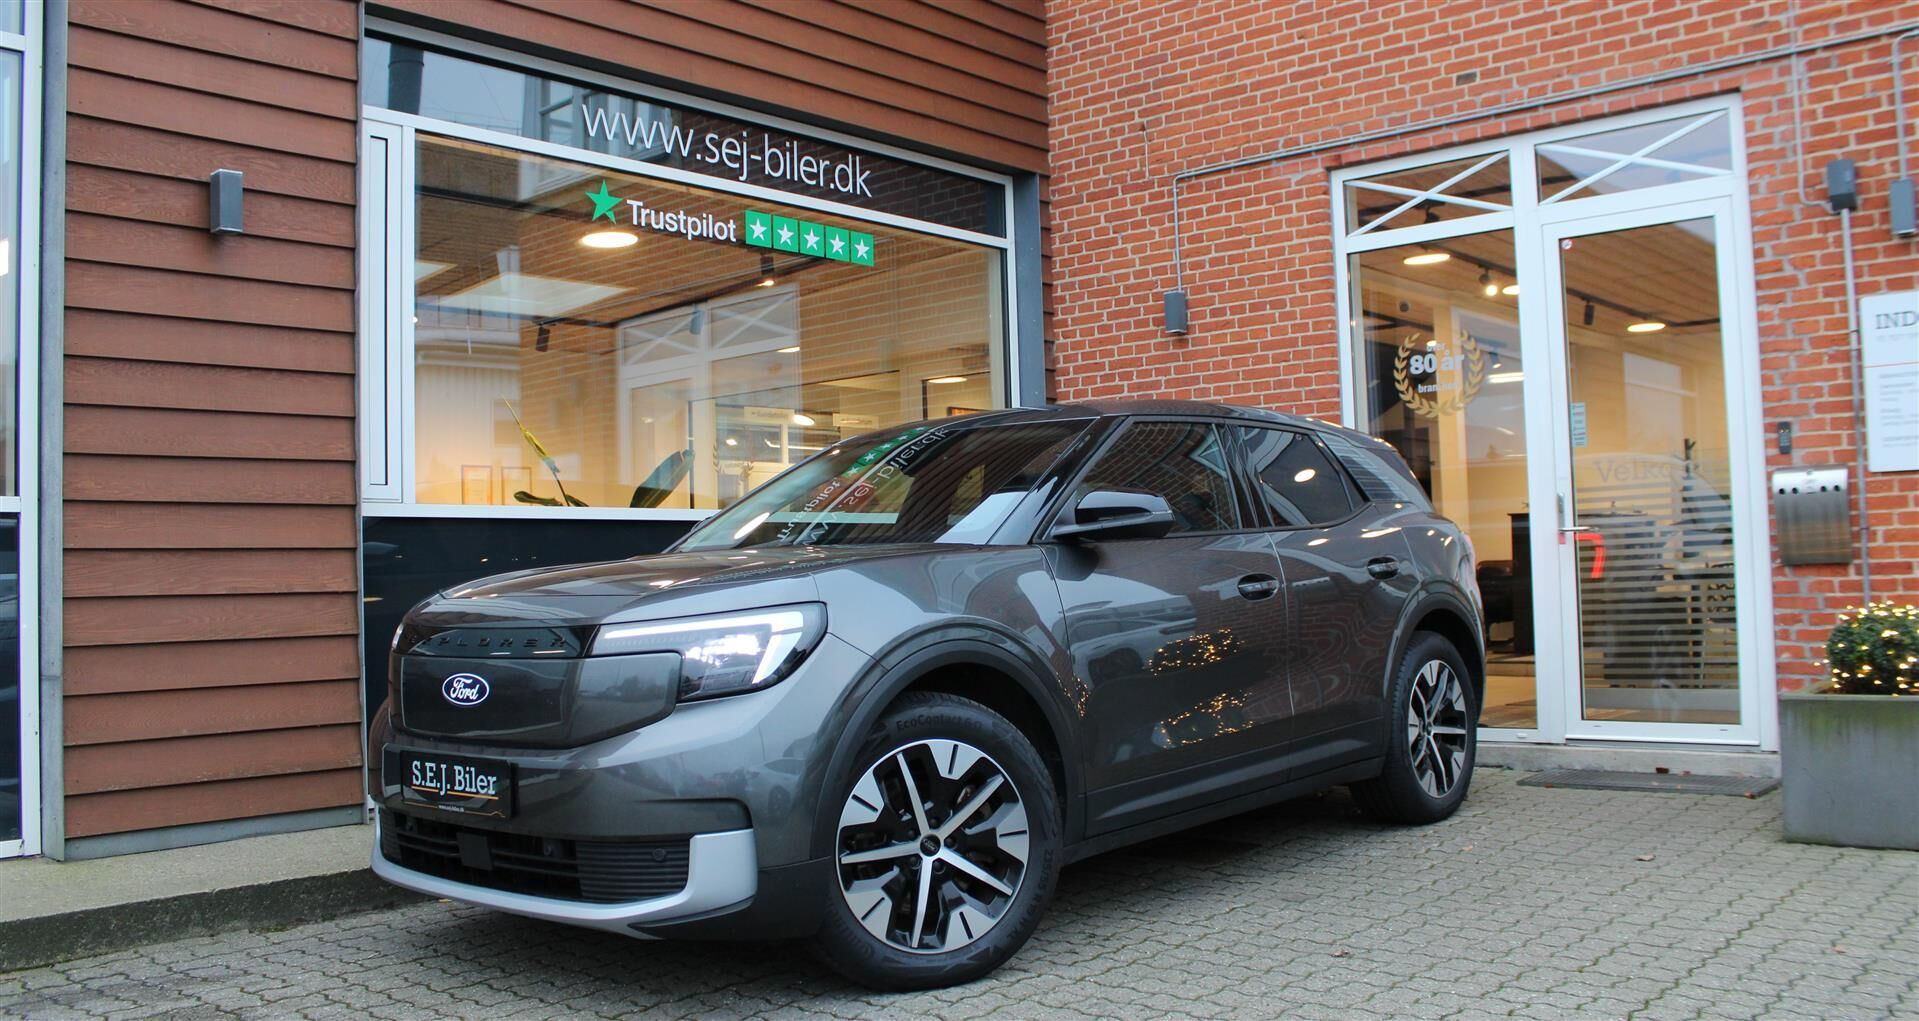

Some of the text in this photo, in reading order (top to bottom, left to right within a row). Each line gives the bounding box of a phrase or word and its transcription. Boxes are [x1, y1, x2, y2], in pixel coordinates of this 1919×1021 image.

[582, 103, 872, 198] www.sej-biler.dk
[626, 199, 737, 242] Trustpilot
[1875, 310, 1919, 330] IND
[1409, 350, 1465, 375] 80 år
[450, 677, 481, 700] Ford
[412, 759, 497, 796] S.E.J. Biler
